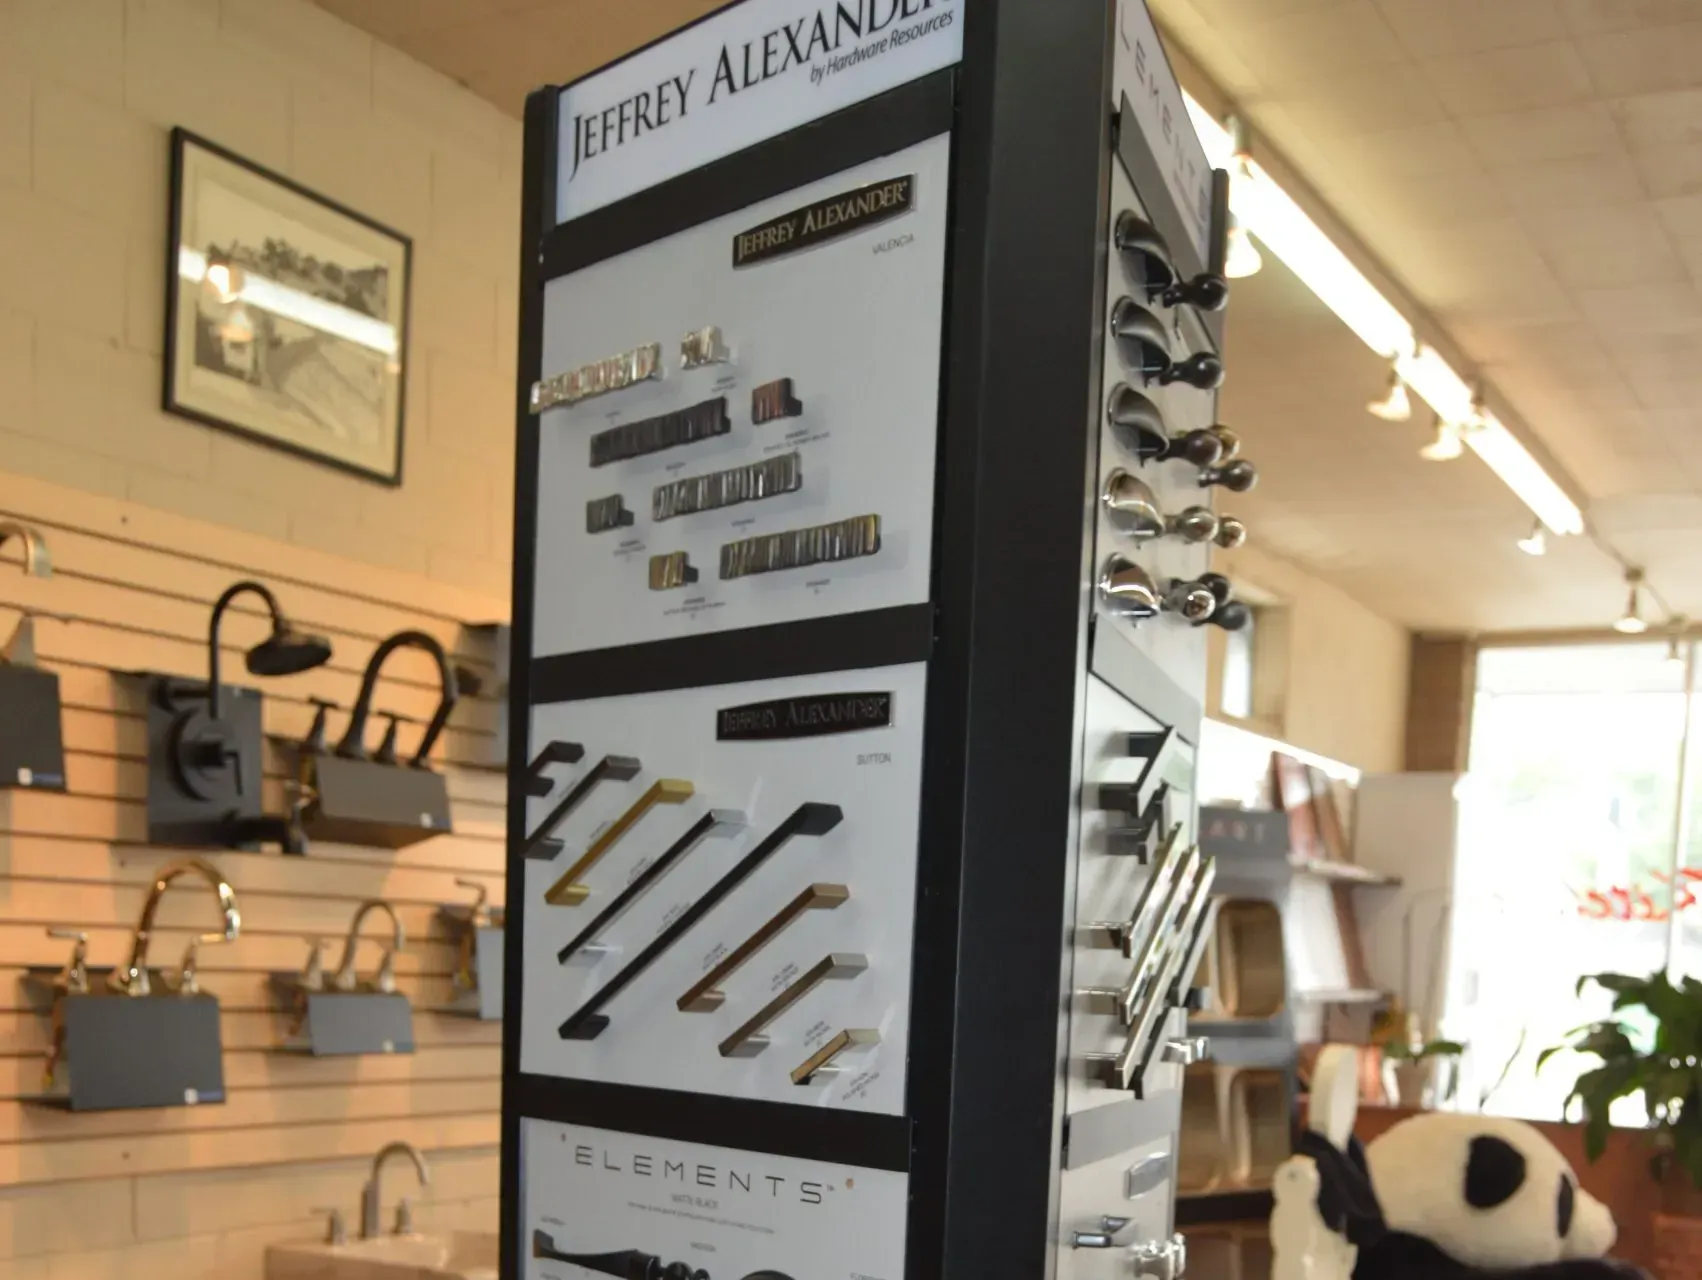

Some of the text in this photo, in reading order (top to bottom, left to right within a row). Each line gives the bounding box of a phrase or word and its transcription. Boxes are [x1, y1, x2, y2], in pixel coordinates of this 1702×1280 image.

[810, 9, 955, 86] by Hardware Resources
[569, 70, 696, 182] JEFFREY
[738, 217, 798, 263] JEFFREY
[872, 233, 915, 256] VALENCIA
[574, 1145, 822, 1206] ELEMENTS
